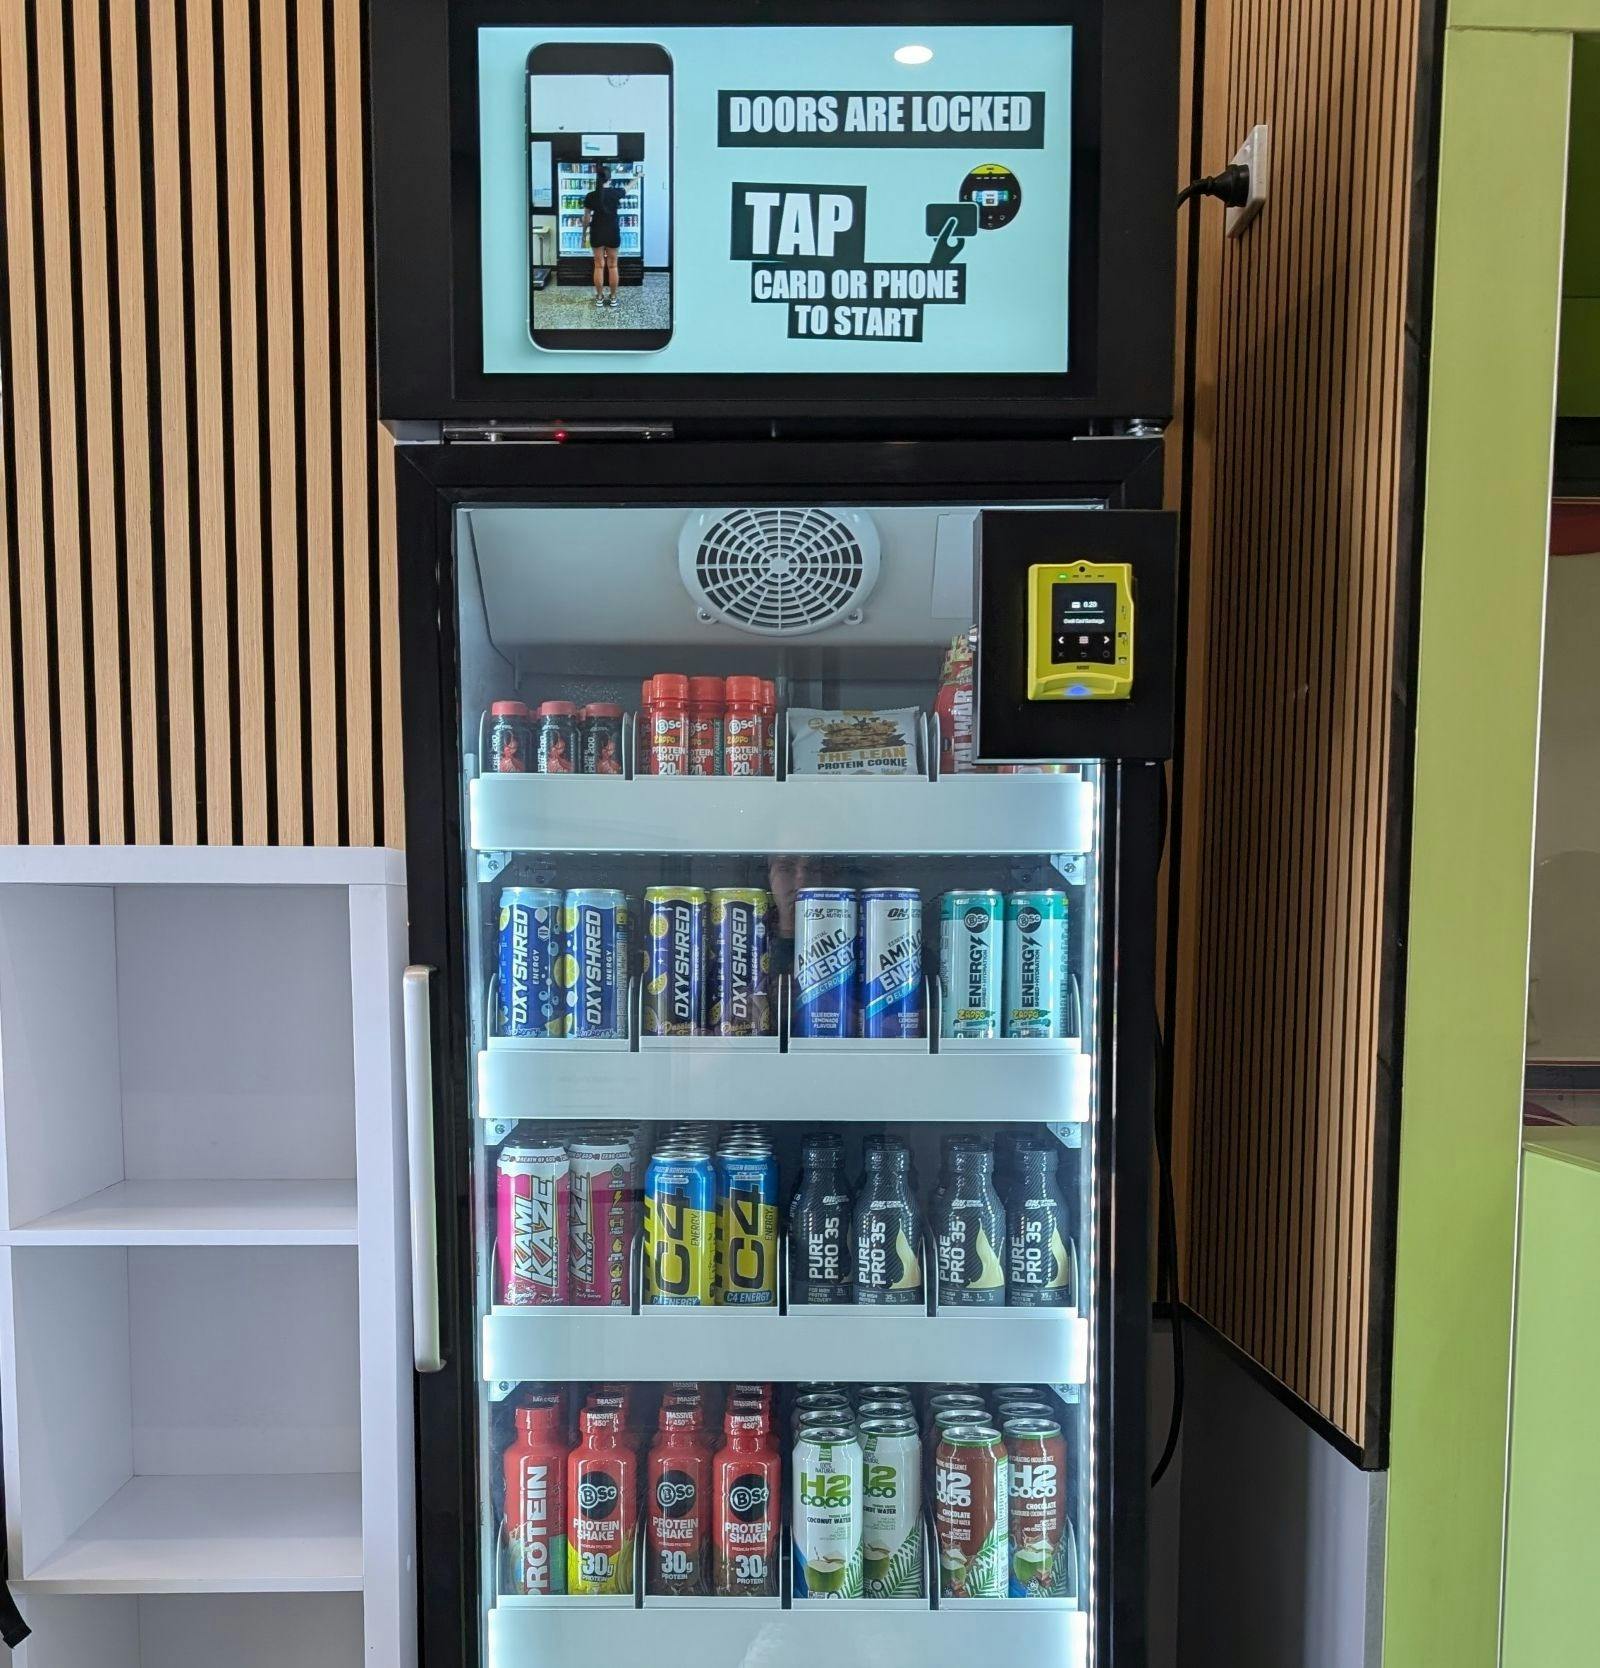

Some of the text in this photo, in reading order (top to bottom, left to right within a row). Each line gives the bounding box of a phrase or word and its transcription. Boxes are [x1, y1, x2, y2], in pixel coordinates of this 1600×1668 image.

[730, 96, 1032, 133] DOORS ARE LOCKED
[745, 191, 853, 257] TAP
[754, 269, 958, 299] CARD OR PHONE
[794, 305, 918, 337] TO START
[652, 746, 686, 755] PROTEIN
[656, 753, 680, 762] SHOT
[725, 746, 759, 755] PROTEIN
[729, 753, 754, 762] SHOT
[817, 746, 907, 763] THE LEAN
[817, 758, 908, 770] PROTEIN COOKIE
[512, 909, 528, 1024] OXYSHRED
[532, 949, 540, 985] ENERGY
[585, 910, 602, 1025] OXYSHRED
[606, 949, 614, 986] ENERGY
[674, 906, 690, 1018] OXYSHRED
[732, 907, 747, 1018] OXYSHRED
[969, 935, 986, 1008] ENERGY
[1021, 935, 1038, 1008] ENERGY
[514, 1195, 532, 1279] KAMI
[531, 1174, 555, 1287] KAZE
[690, 1214, 699, 1247] ENERGY
[729, 1184, 764, 1289] C4
[764, 1208, 773, 1241] ENERGY
[654, 1187, 691, 1295] C4
[808, 1233, 824, 1279] PURE
[825, 1217, 840, 1279] PRO 35
[871, 1222, 886, 1286] PRO 35
[950, 1220, 966, 1284] PRO 35
[1026, 1221, 1042, 1284] PRO 35
[858, 1236, 870, 1284] PURE
[939, 1235, 950, 1282] PURE
[1011, 1236, 1026, 1283] PURE
[727, 1291, 771, 1303] C4 ENERGY
[586, 1412, 614, 1421] MASSIVE
[666, 1411, 694, 1420] MASSIVE
[734, 1415, 763, 1424] MASSIVE
[800, 1472, 852, 1498] H2
[936, 1466, 972, 1496] H2
[1009, 1463, 1057, 1488] H2
[807, 1517, 832, 1525] COCONUT
[942, 1508, 971, 1519] CHOCOLATE
[1025, 1501, 1057, 1511] CHOCOLATE
[573, 1519, 620, 1532] PROTEIN
[577, 1530, 615, 1542] SHAKE
[652, 1516, 699, 1529] PROTEIN
[656, 1527, 694, 1539] SHAKE
[725, 1521, 772, 1534] PROTEIN
[729, 1532, 768, 1544] SHAKE
[581, 1552, 615, 1578] 30g
[660, 1550, 693, 1574] 30g
[735, 1554, 768, 1579] 30g
[736, 1577, 764, 1585] PROTEIN
